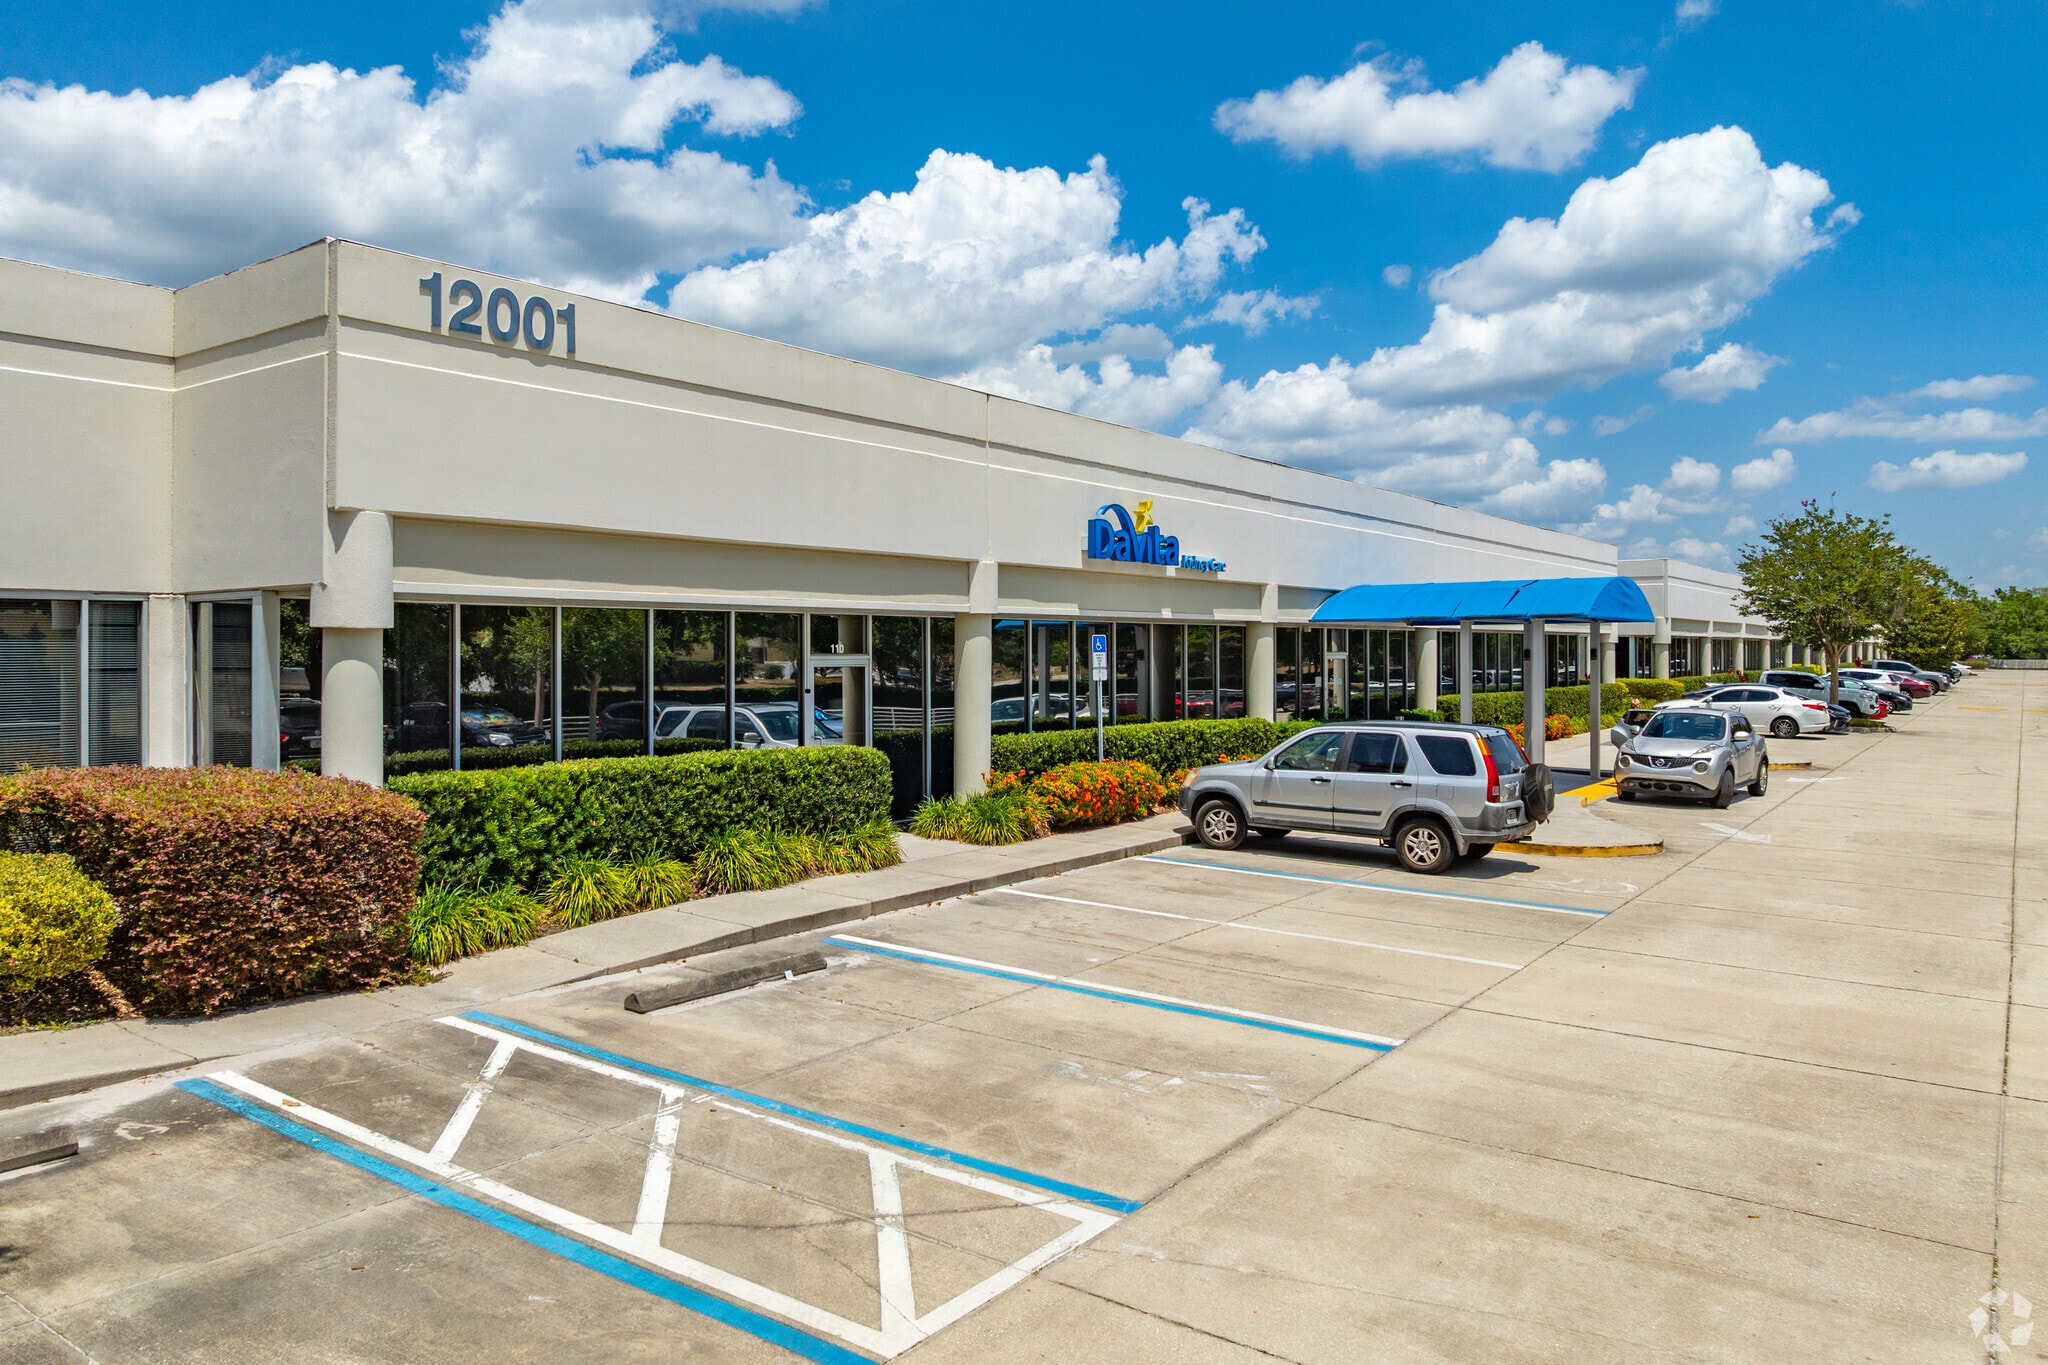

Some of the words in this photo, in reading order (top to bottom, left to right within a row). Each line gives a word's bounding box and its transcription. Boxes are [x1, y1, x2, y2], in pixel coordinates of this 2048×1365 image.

[419, 271, 576, 353] 12001
[1088, 503, 1179, 566] DaVita
[830, 643, 845, 654] 110
